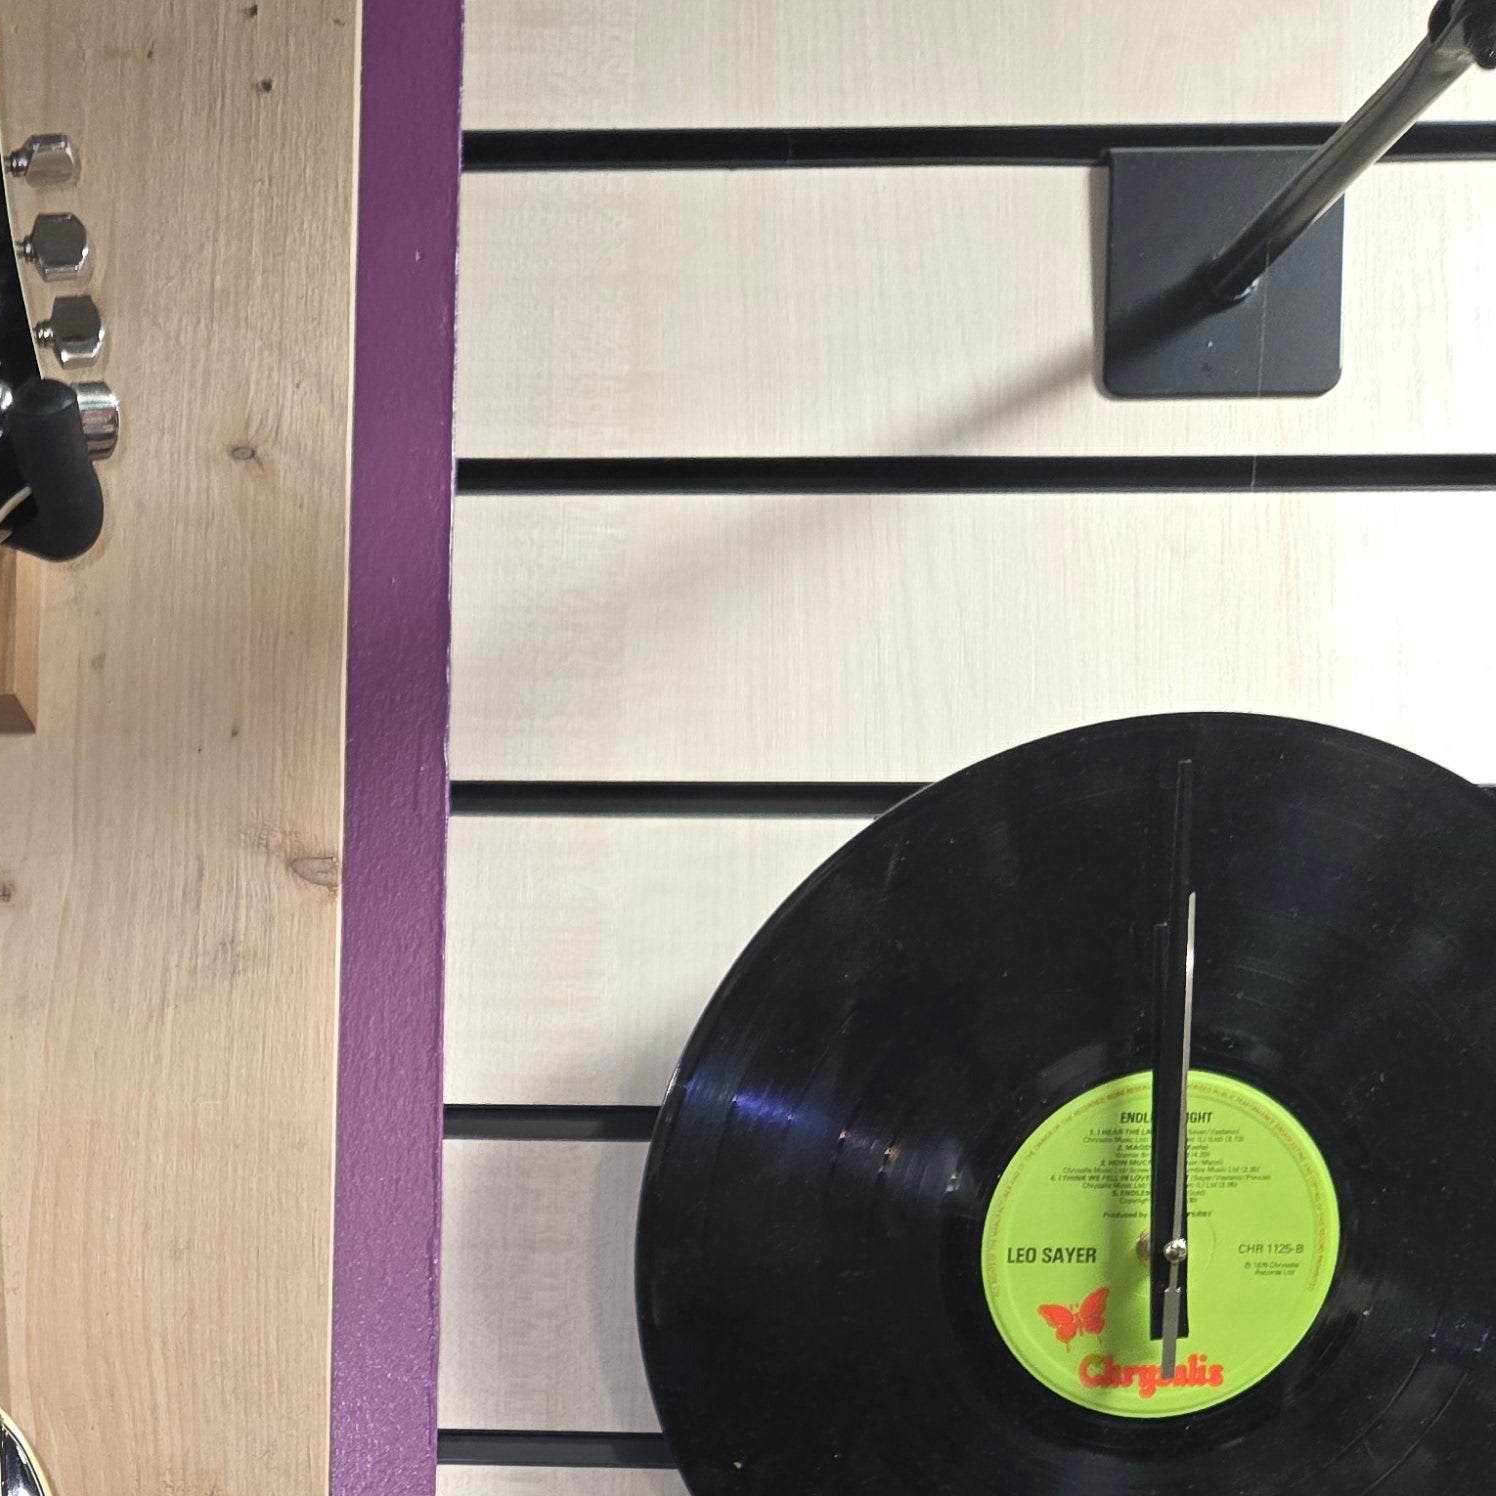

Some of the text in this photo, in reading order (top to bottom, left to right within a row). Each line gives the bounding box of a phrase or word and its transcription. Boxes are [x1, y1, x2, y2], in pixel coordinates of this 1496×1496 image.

[1120, 1111, 1213, 1124] ENDL IGHT
[1238, 1243, 1304, 1254] CHR 1125-B
[1007, 1247, 1097, 1264] LEO SAYER
